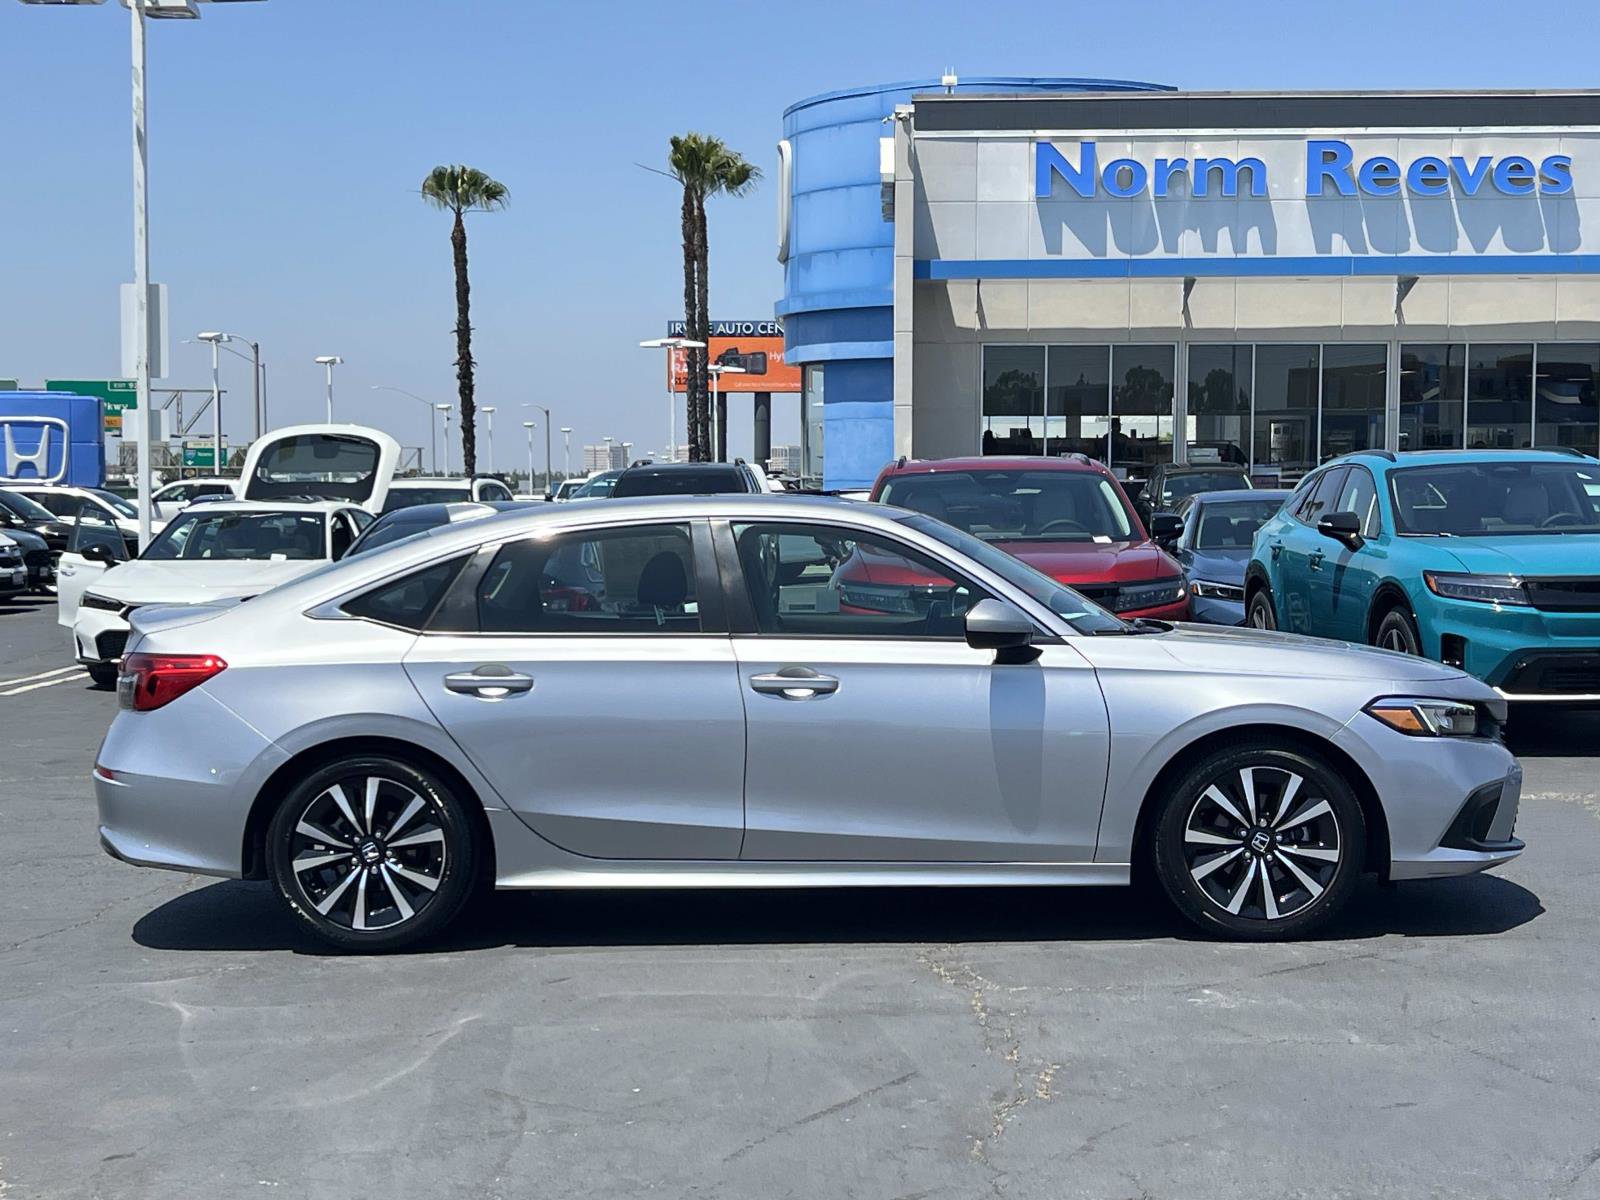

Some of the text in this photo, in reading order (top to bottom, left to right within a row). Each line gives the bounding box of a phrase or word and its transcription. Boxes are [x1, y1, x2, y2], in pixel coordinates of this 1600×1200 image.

[1036, 140, 1573, 198] Norm Reeves
[716, 322, 754, 334] AUTO
